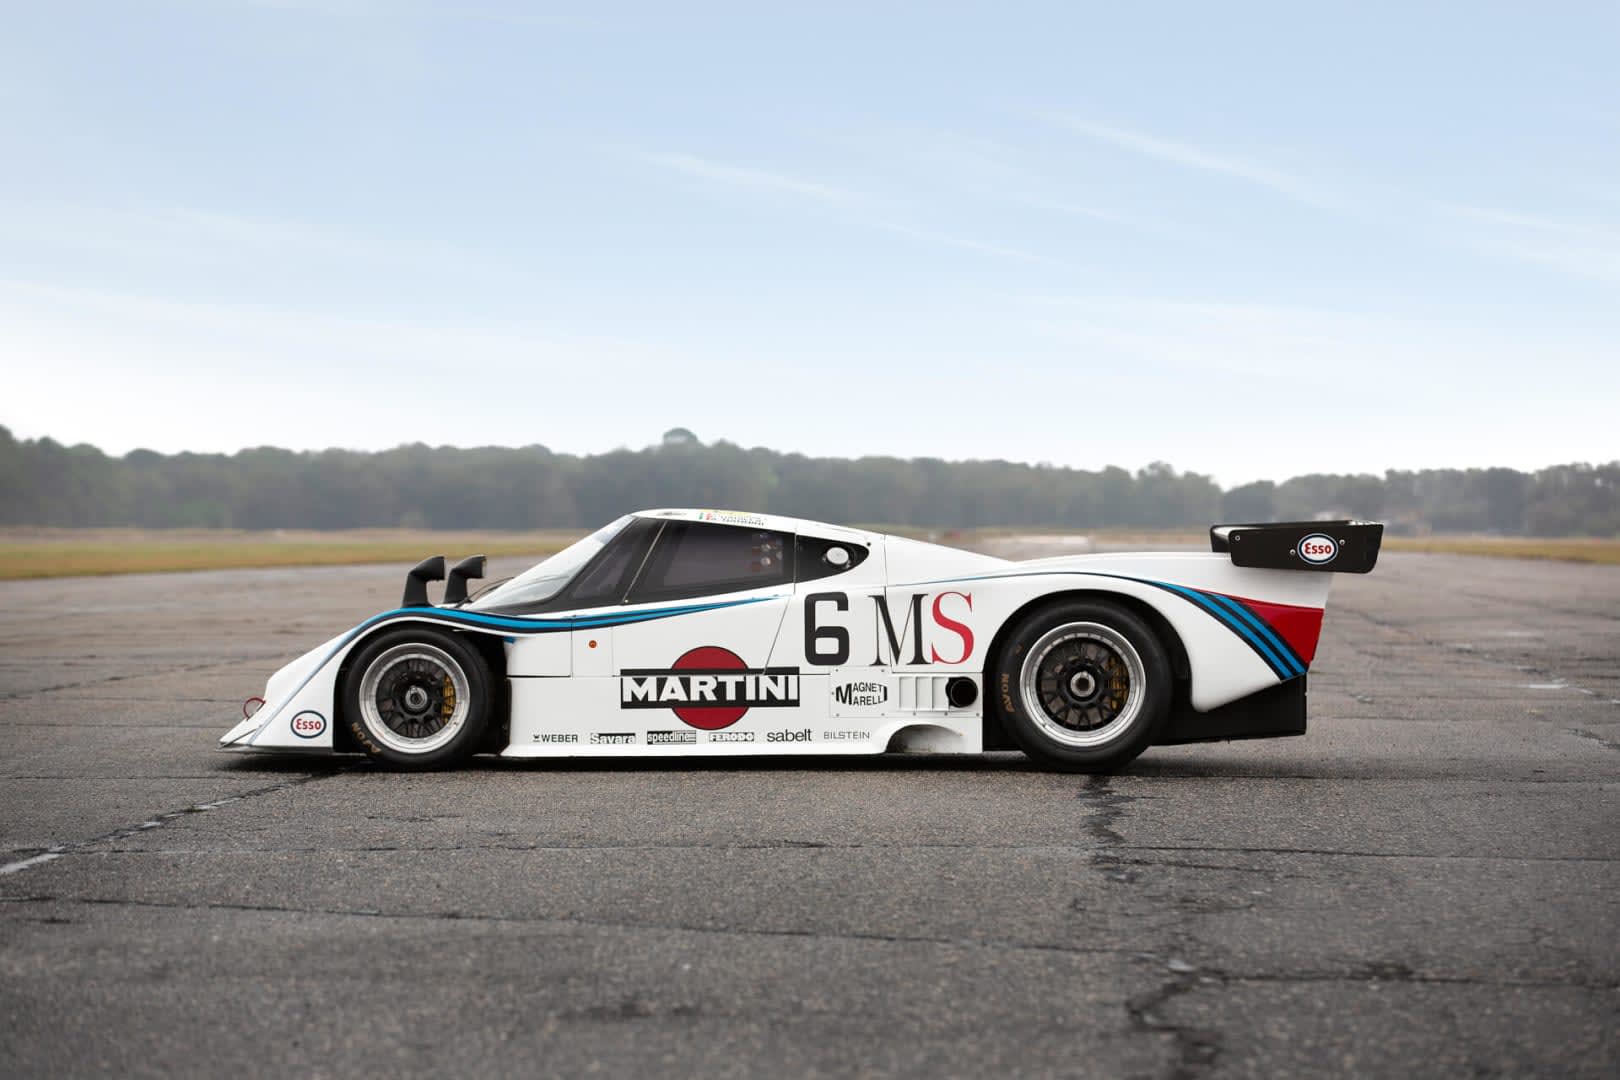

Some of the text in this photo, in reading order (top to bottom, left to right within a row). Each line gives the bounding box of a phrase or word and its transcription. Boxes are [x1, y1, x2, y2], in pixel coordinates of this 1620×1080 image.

[1304, 542, 1332, 555] Esso
[804, 591, 850, 666] 6
[867, 591, 975, 667] MS
[622, 675, 798, 703] MARTINI
[296, 718, 322, 731] Esso
[541, 734, 579, 743] WEBER
[590, 733, 636, 744] Savara
[767, 729, 813, 742] sabelt
[823, 731, 870, 740] BILSTEIN
